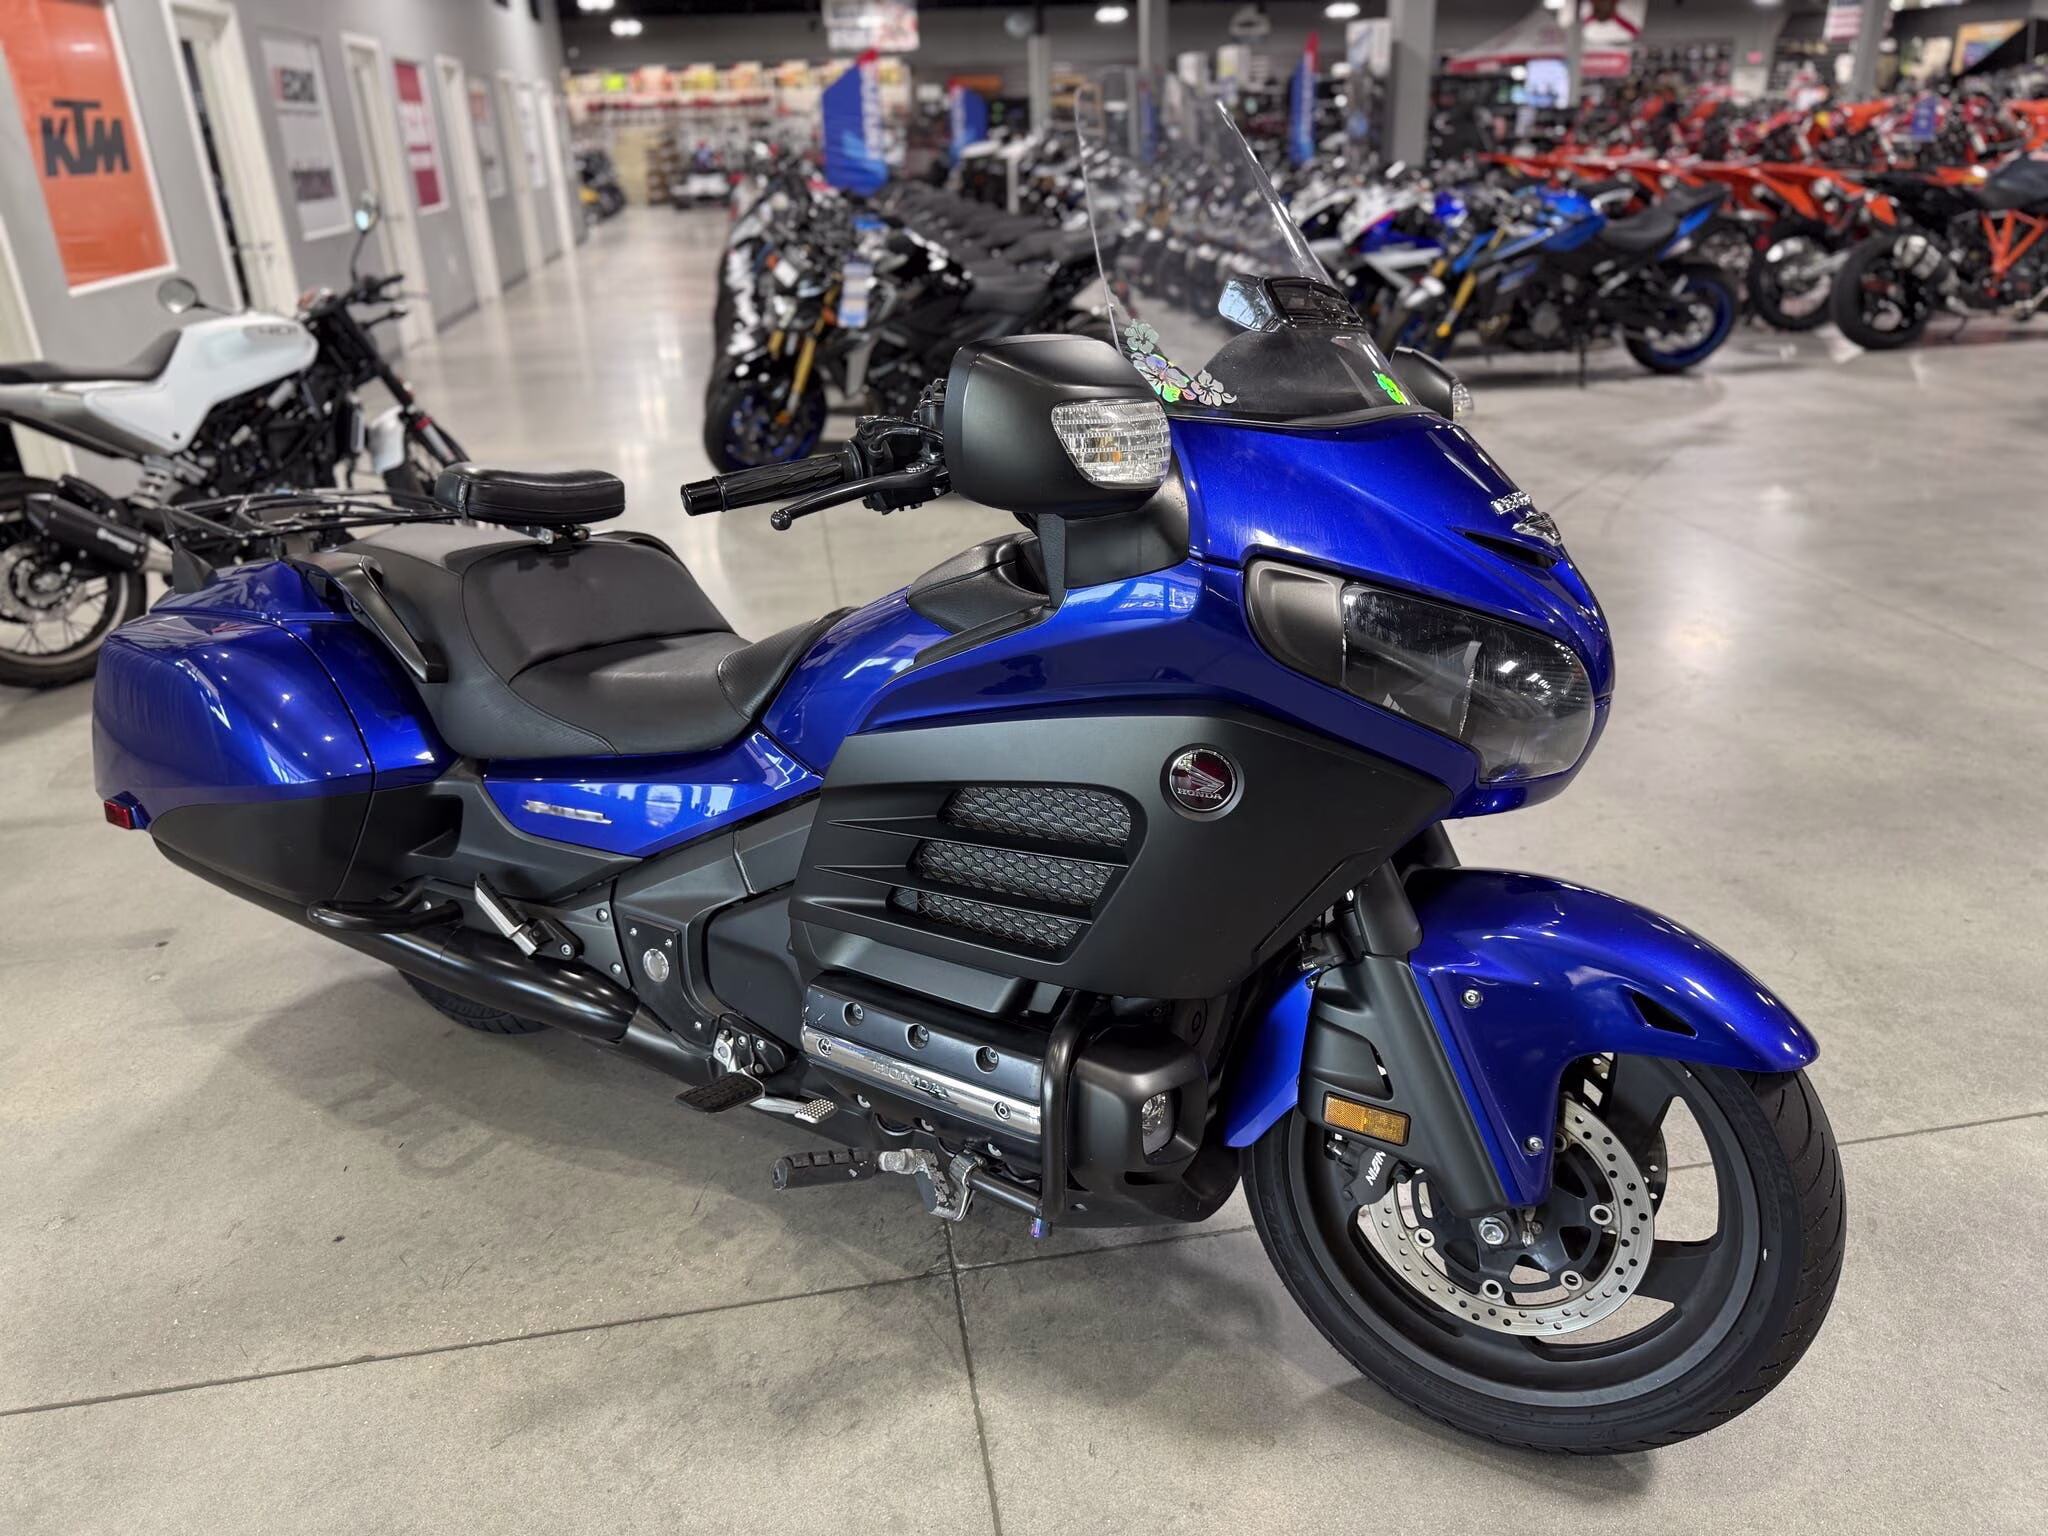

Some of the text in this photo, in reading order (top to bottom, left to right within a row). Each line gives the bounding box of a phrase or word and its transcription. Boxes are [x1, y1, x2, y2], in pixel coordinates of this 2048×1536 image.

[41, 99, 130, 177] KTM
[1177, 787, 1223, 800] HONDA
[872, 1060, 951, 1098] HONDA
